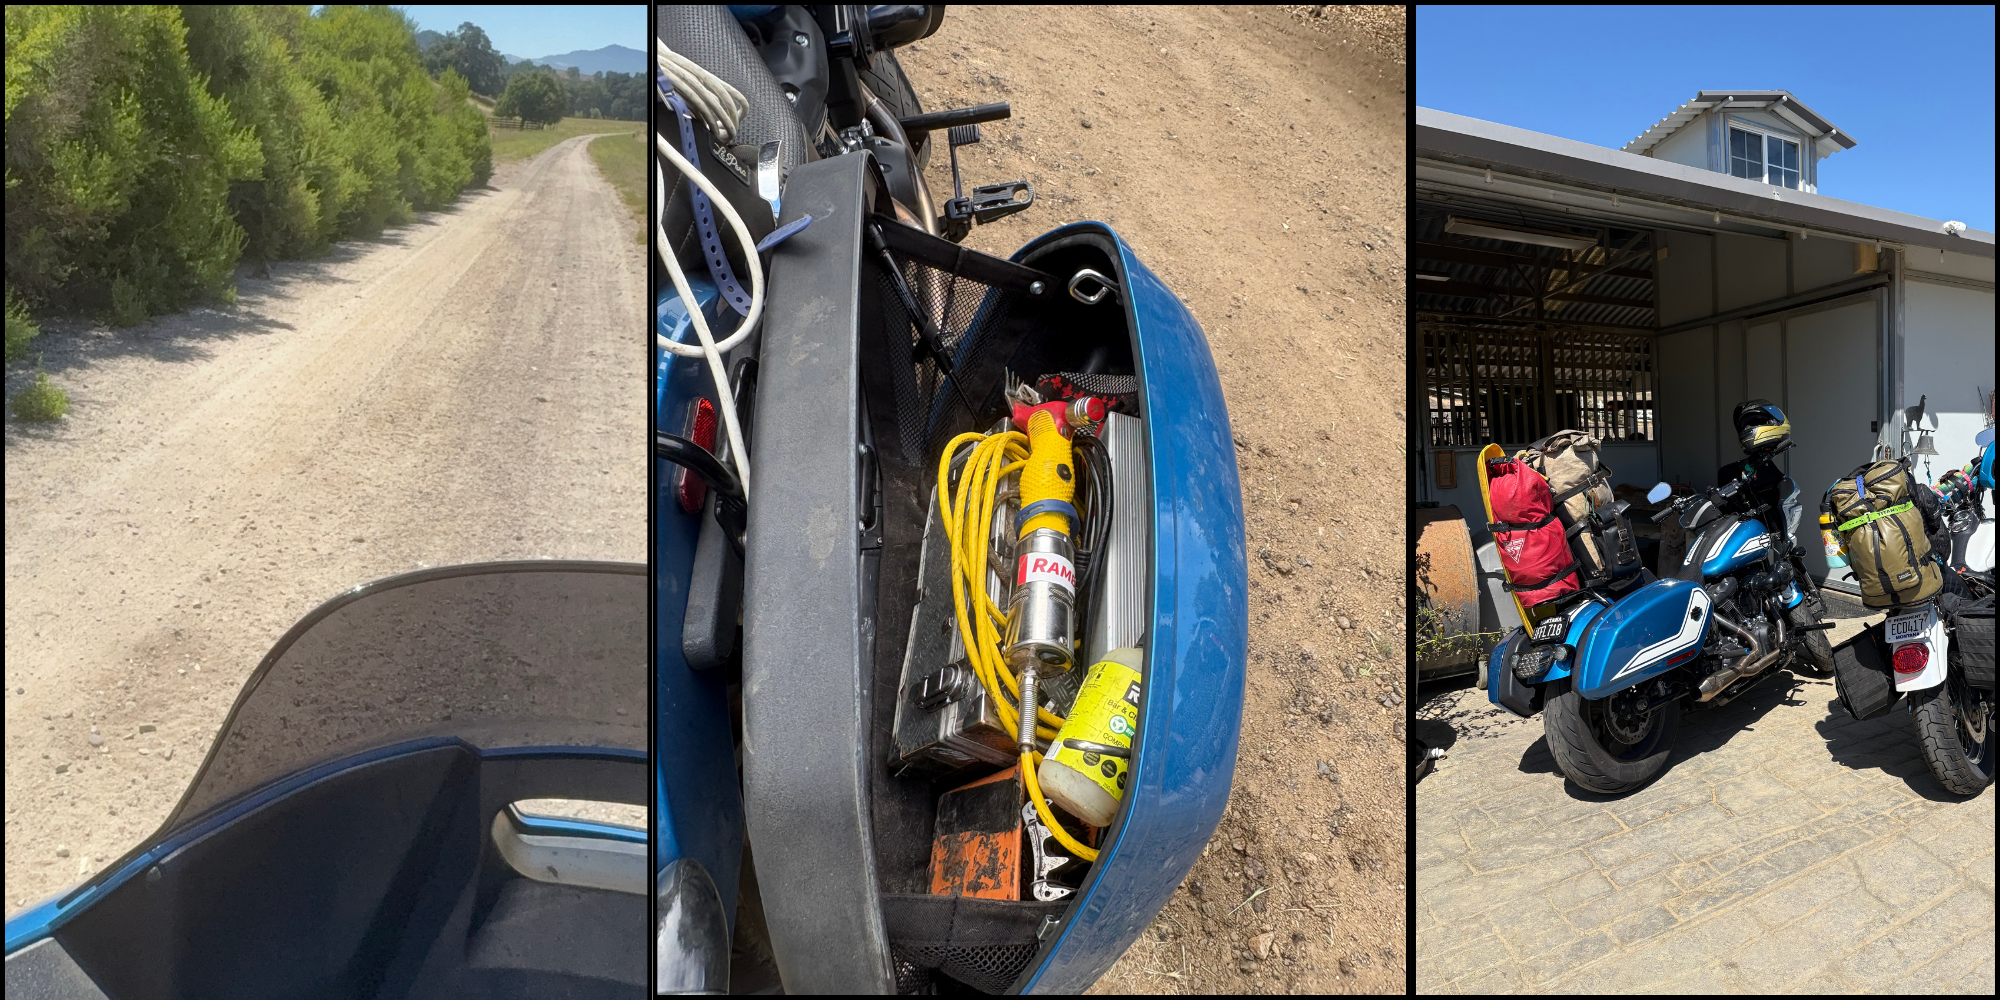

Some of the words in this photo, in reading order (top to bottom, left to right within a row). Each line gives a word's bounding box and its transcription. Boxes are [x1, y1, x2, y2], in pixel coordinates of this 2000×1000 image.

[1891, 619, 1925, 636] ECD417
[1895, 631, 1921, 641] MONTANA
[1107, 699, 1121, 710] Bar
[1121, 706, 1128, 714] &
